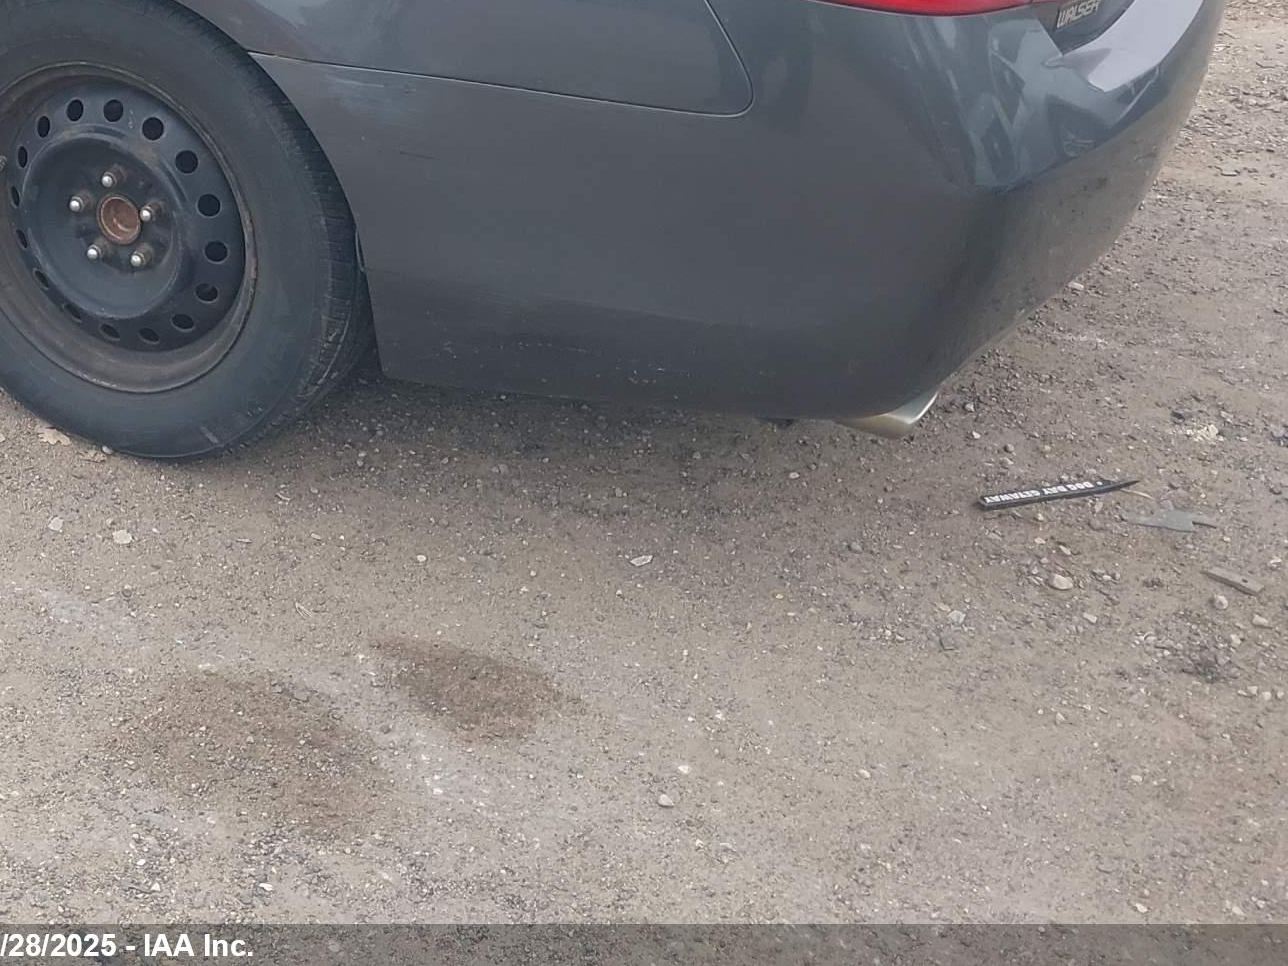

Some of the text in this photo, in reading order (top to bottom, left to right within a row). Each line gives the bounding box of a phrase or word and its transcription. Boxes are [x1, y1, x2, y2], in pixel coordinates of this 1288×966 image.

[984, 481, 1094, 504] DOG DAY GETAWAY
